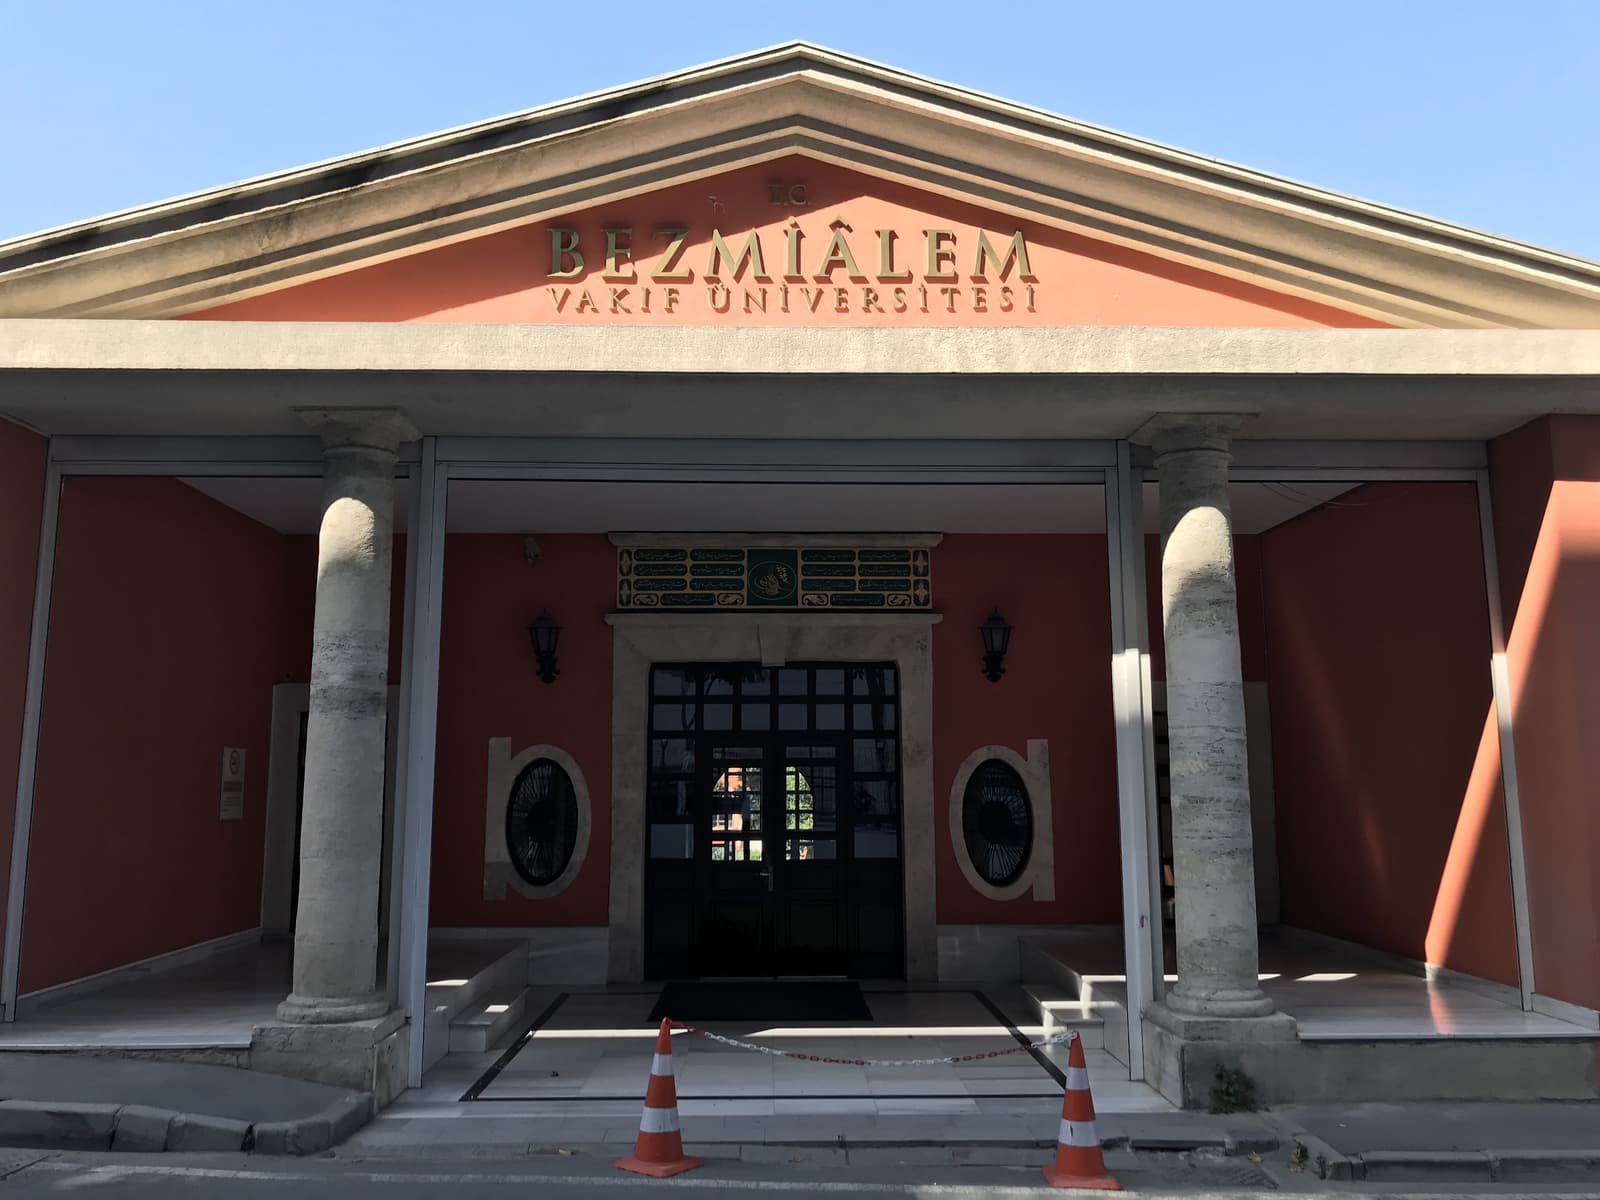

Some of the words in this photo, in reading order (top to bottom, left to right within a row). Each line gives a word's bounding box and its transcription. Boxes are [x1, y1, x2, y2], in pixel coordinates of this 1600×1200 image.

[546, 216, 1036, 281] BEZMİÂLEM
[546, 287, 681, 312] VAKIF
[707, 282, 1035, 312] ÜNİVERSİTESİ
